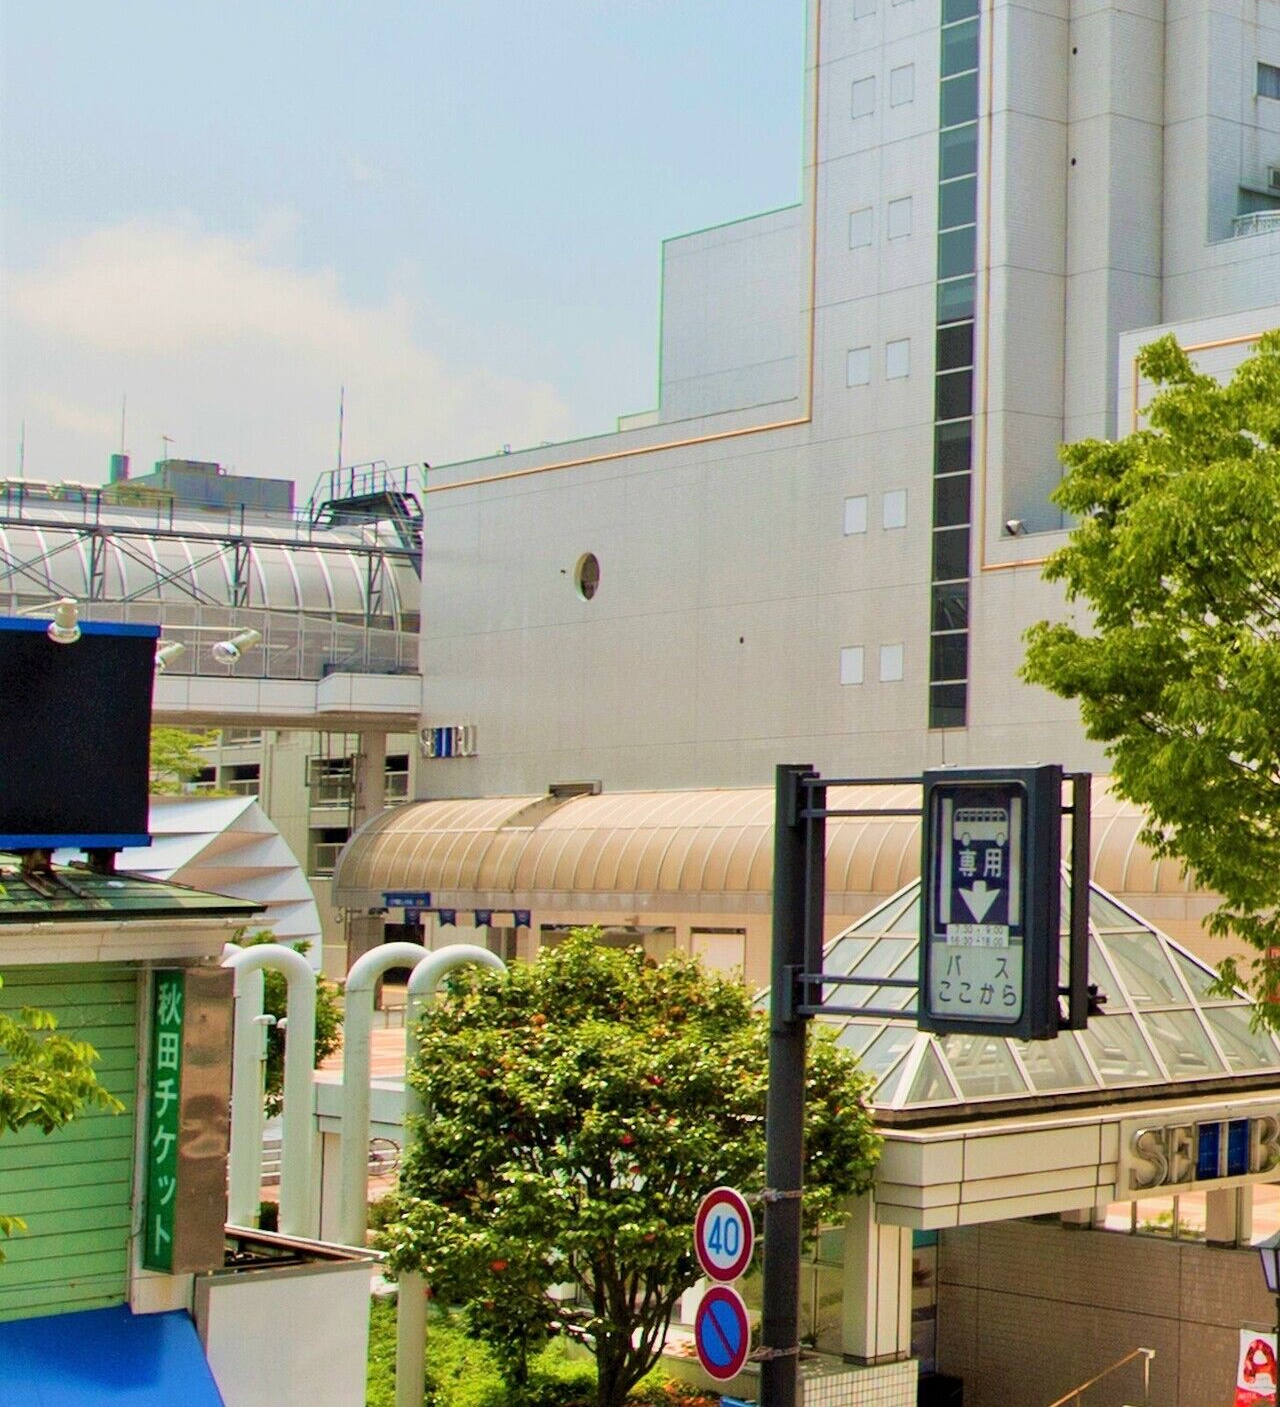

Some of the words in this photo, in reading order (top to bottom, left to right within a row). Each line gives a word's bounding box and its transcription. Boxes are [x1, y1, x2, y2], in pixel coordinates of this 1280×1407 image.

[958, 848, 1003, 877] 専用
[946, 955, 1009, 979] バス
[939, 981, 1017, 1007] ここから
[153, 982, 182, 1256] 秋田チケット
[708, 1215, 740, 1256] 40
